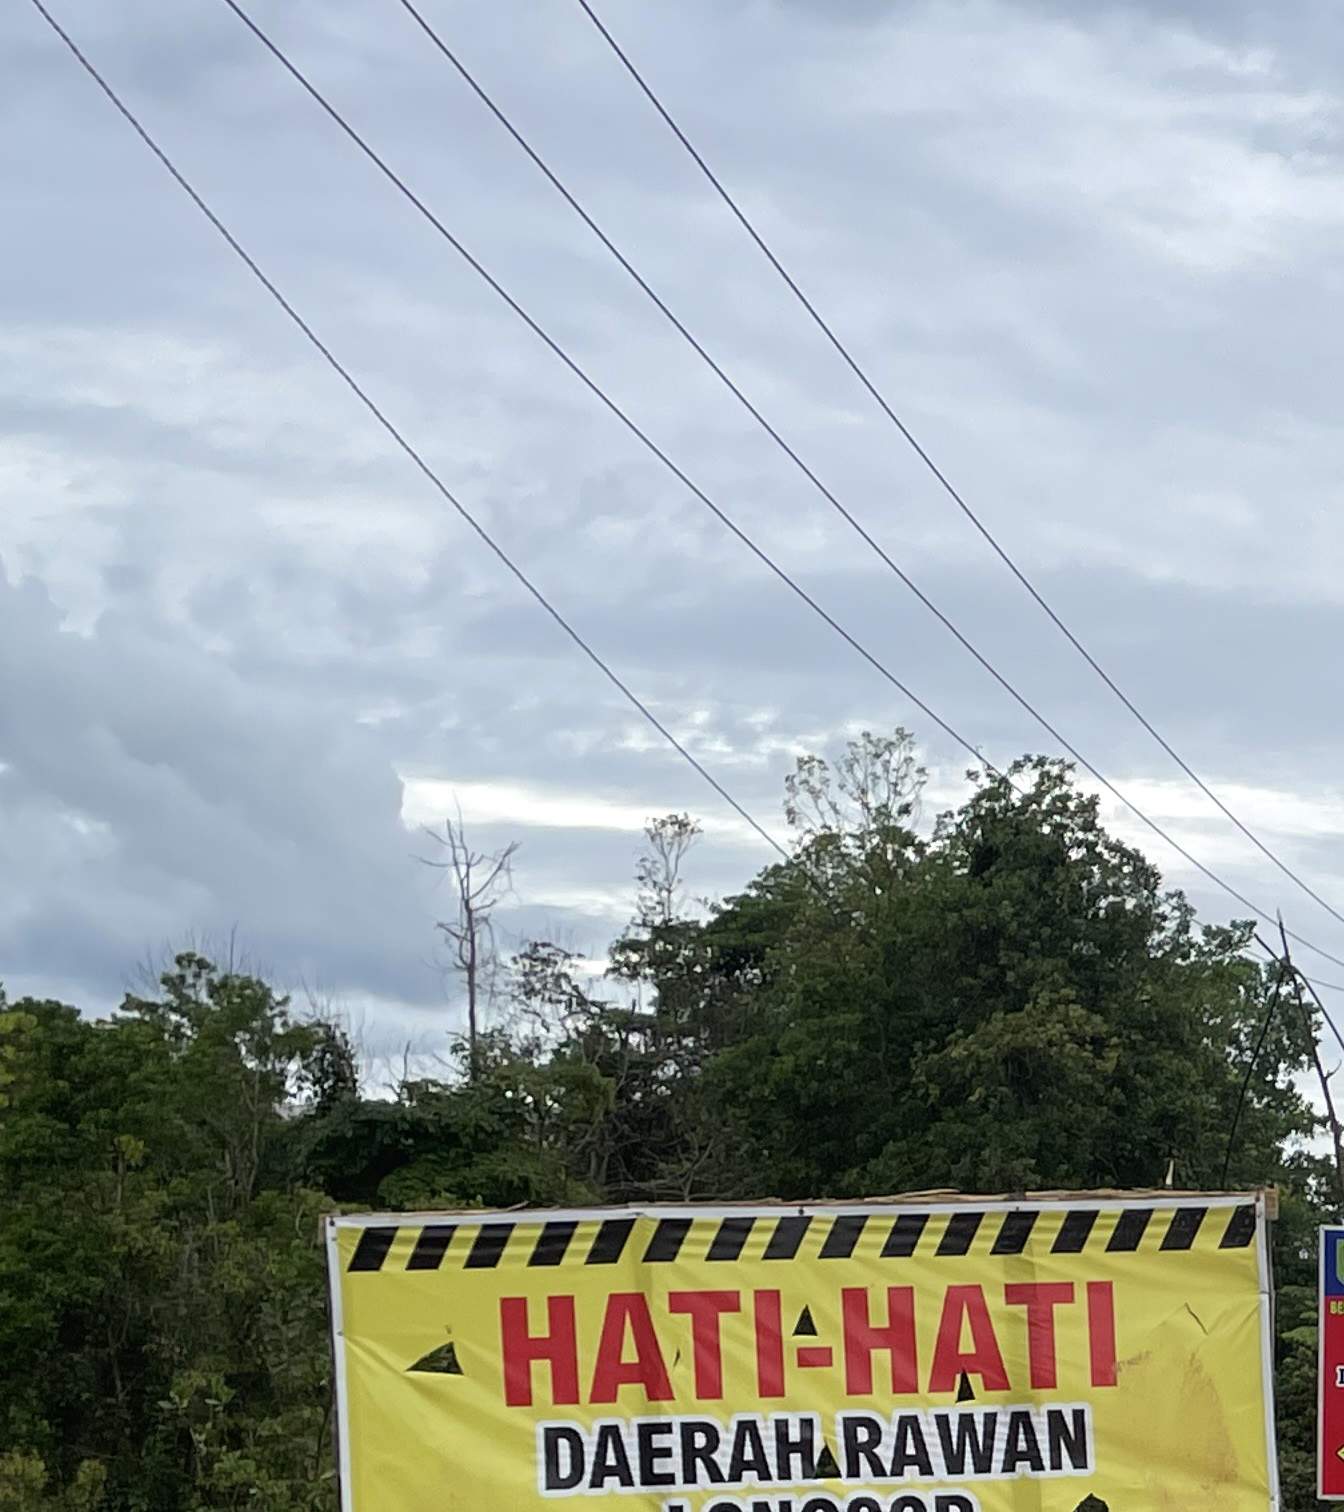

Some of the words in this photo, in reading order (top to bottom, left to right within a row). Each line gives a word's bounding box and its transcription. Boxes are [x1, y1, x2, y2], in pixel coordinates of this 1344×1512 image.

[500, 1280, 1117, 1407] HATI-HATI
[544, 1418, 816, 1490] DAERAH
[842, 1409, 1088, 1478] RAWAN
